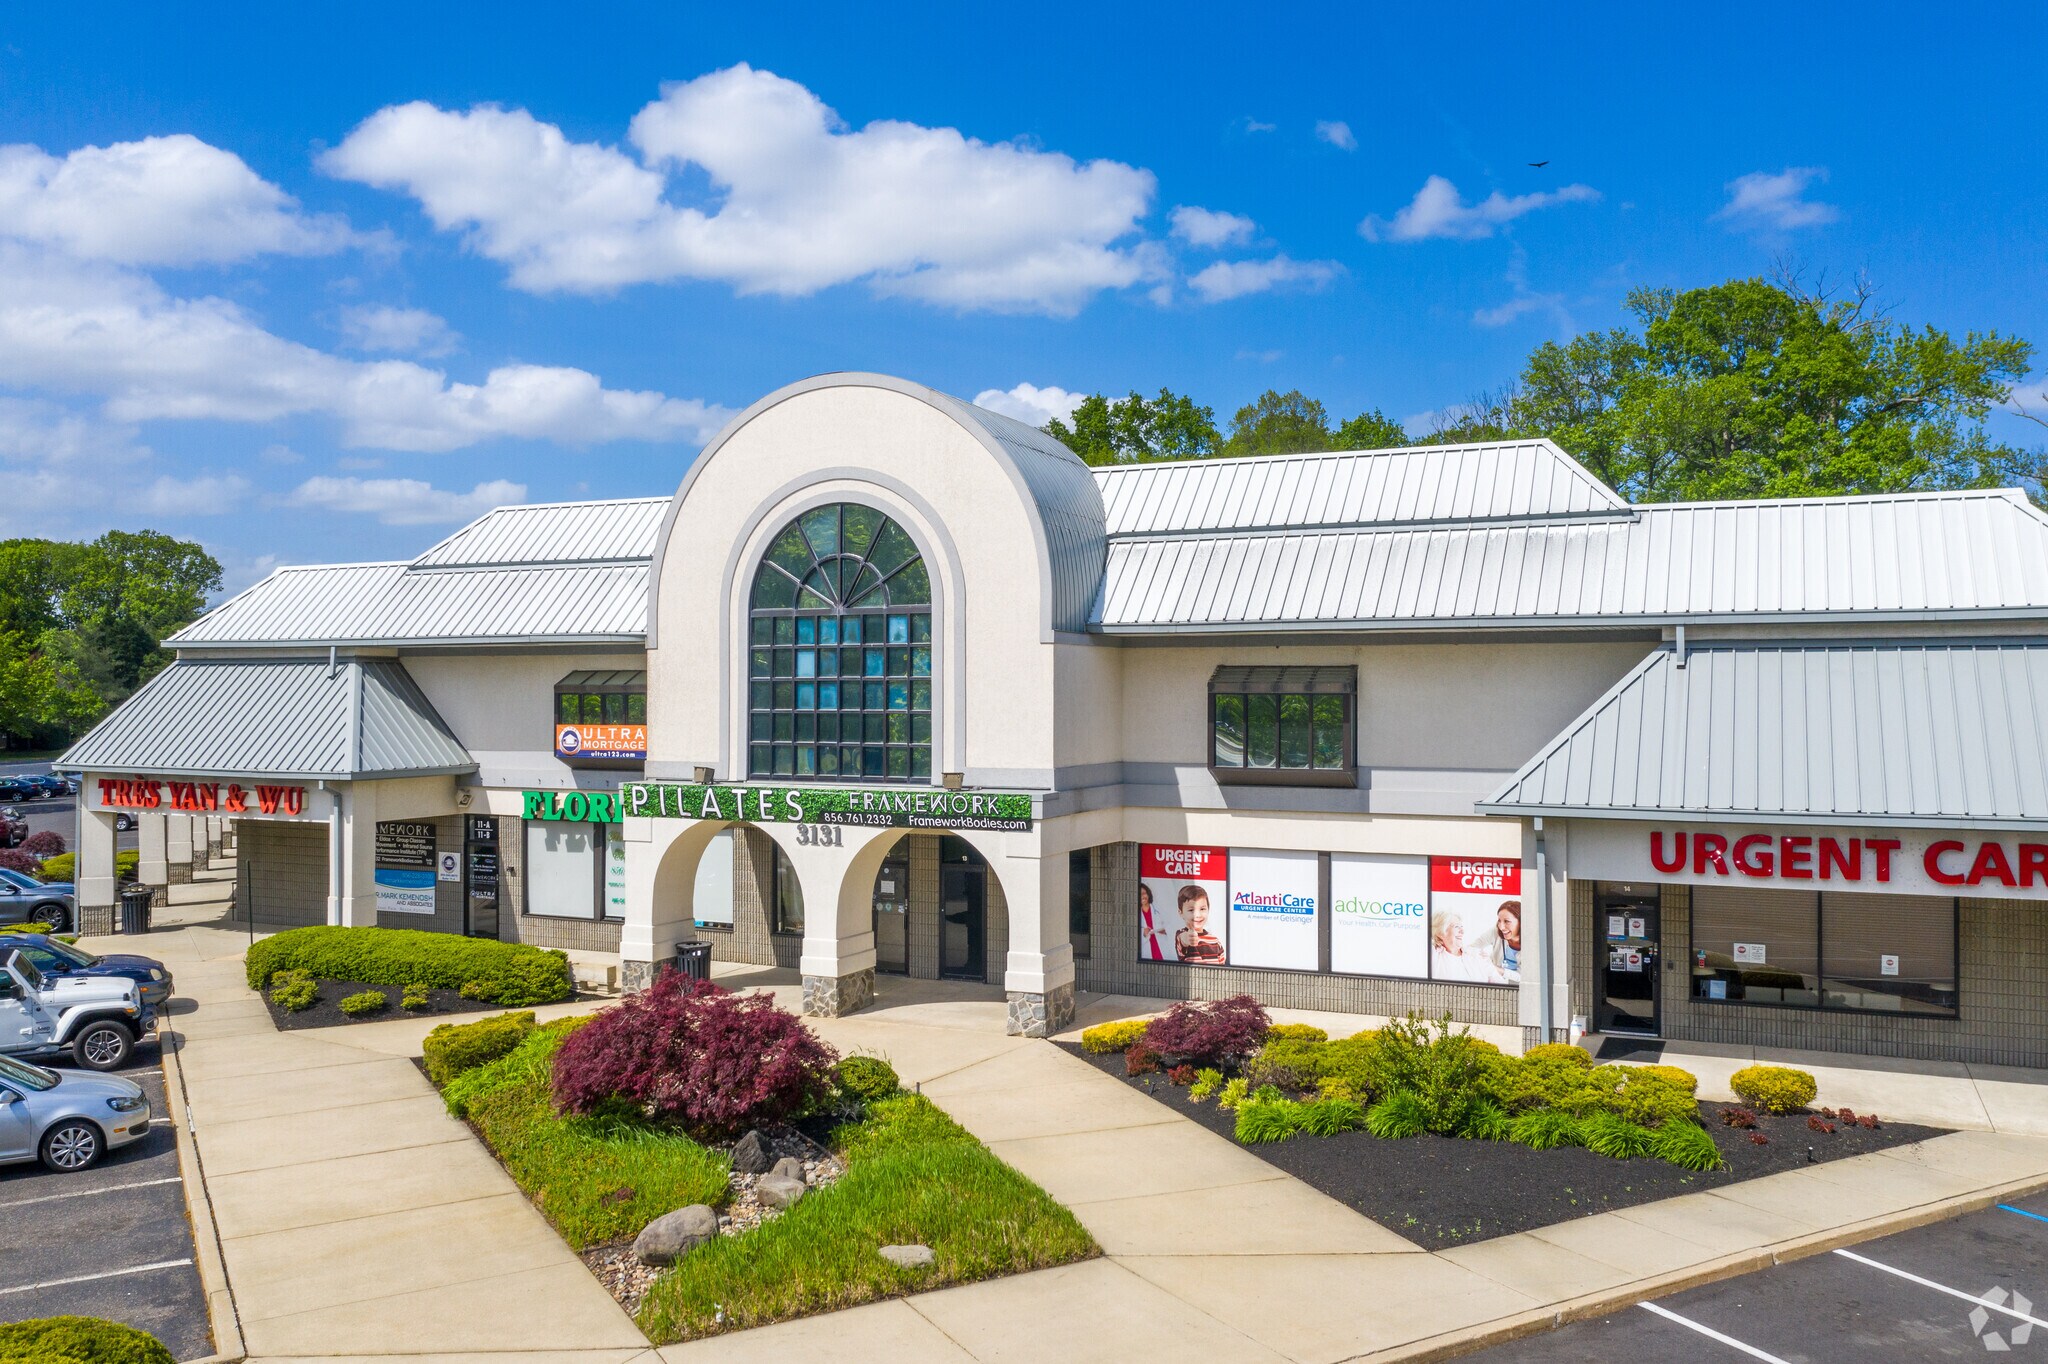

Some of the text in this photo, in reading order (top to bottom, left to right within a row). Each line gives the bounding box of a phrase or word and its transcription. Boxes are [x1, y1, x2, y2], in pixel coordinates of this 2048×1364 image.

[583, 728, 644, 739] ULTRA
[583, 741, 644, 749] MORTGAGE
[98, 775, 304, 816] TRÈS YAN & WU
[631, 786, 804, 821] PILATES
[849, 792, 999, 815] FRAMEWORK
[824, 813, 1027, 830] 856.761.2332 FrameworkBodies.com
[796, 824, 843, 847] 3131
[1155, 849, 1210, 863] URGENT
[1649, 831, 2048, 887] URGENT CAR
[1165, 863, 1201, 875] CARE
[1450, 861, 1515, 877] URGENT
[1461, 876, 1503, 890] CARE
[399, 893, 433, 902] KEMENOSH
[1234, 892, 1314, 907] AtlantiCare
[1335, 897, 1424, 917] advocare
